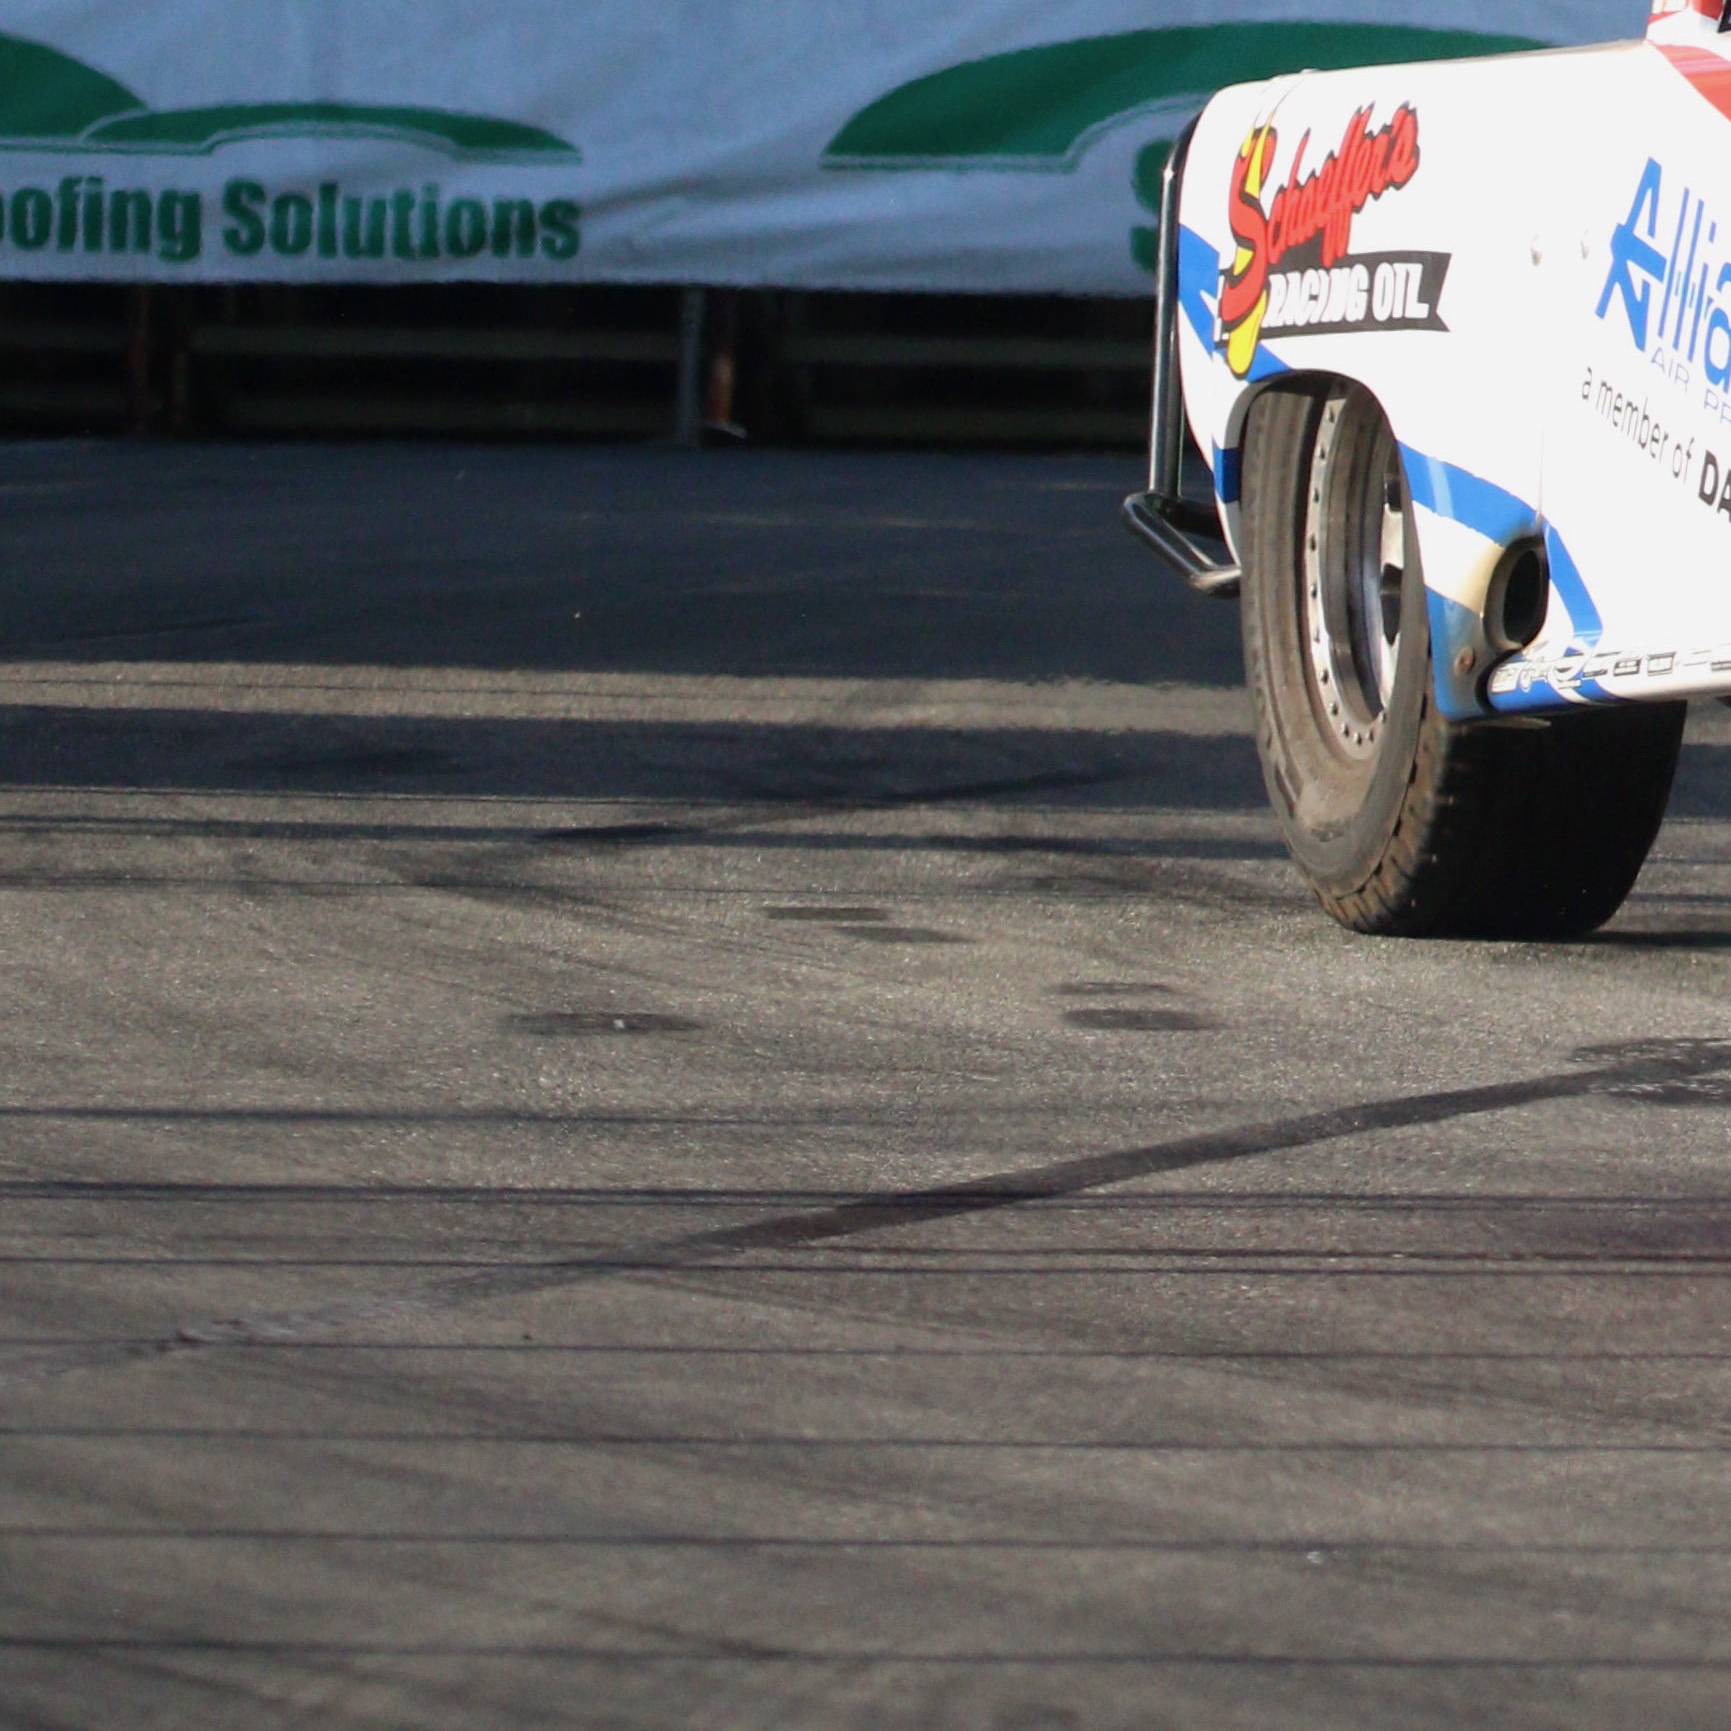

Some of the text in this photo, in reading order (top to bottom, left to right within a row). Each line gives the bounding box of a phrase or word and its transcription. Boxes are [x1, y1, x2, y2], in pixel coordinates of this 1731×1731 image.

[0, 175, 584, 263] ofing Solutions
[1260, 261, 1430, 329] RACING OIL
[1649, 346, 1691, 394] AIR
[1580, 365, 1594, 402] a
[1595, 377, 1670, 464] member
[1672, 436, 1695, 486] of
